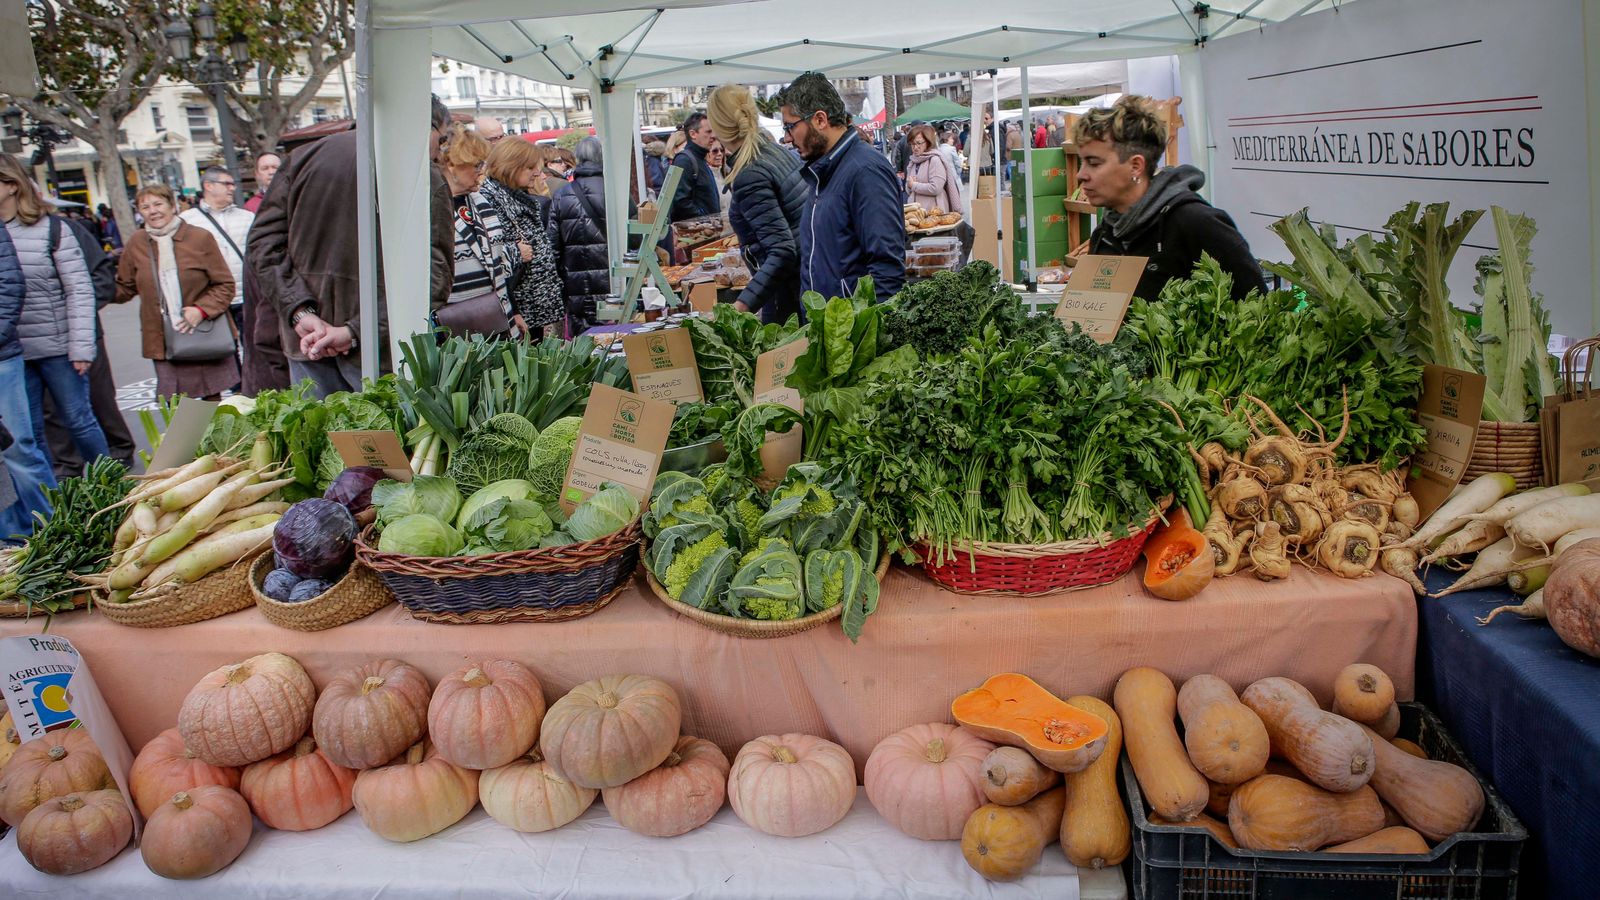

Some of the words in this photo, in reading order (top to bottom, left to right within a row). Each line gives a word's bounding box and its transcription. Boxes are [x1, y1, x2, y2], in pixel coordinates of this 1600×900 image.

[1232, 126, 1363, 164] MEDITERRÁNEA
[1367, 131, 1398, 165] DE
[1402, 127, 1535, 168] SABORES
[1065, 300, 1080, 308] BIO
[1083, 301, 1107, 311] KALE
[585, 447, 610, 460] COLS
[572, 478, 598, 491] GODELLA
